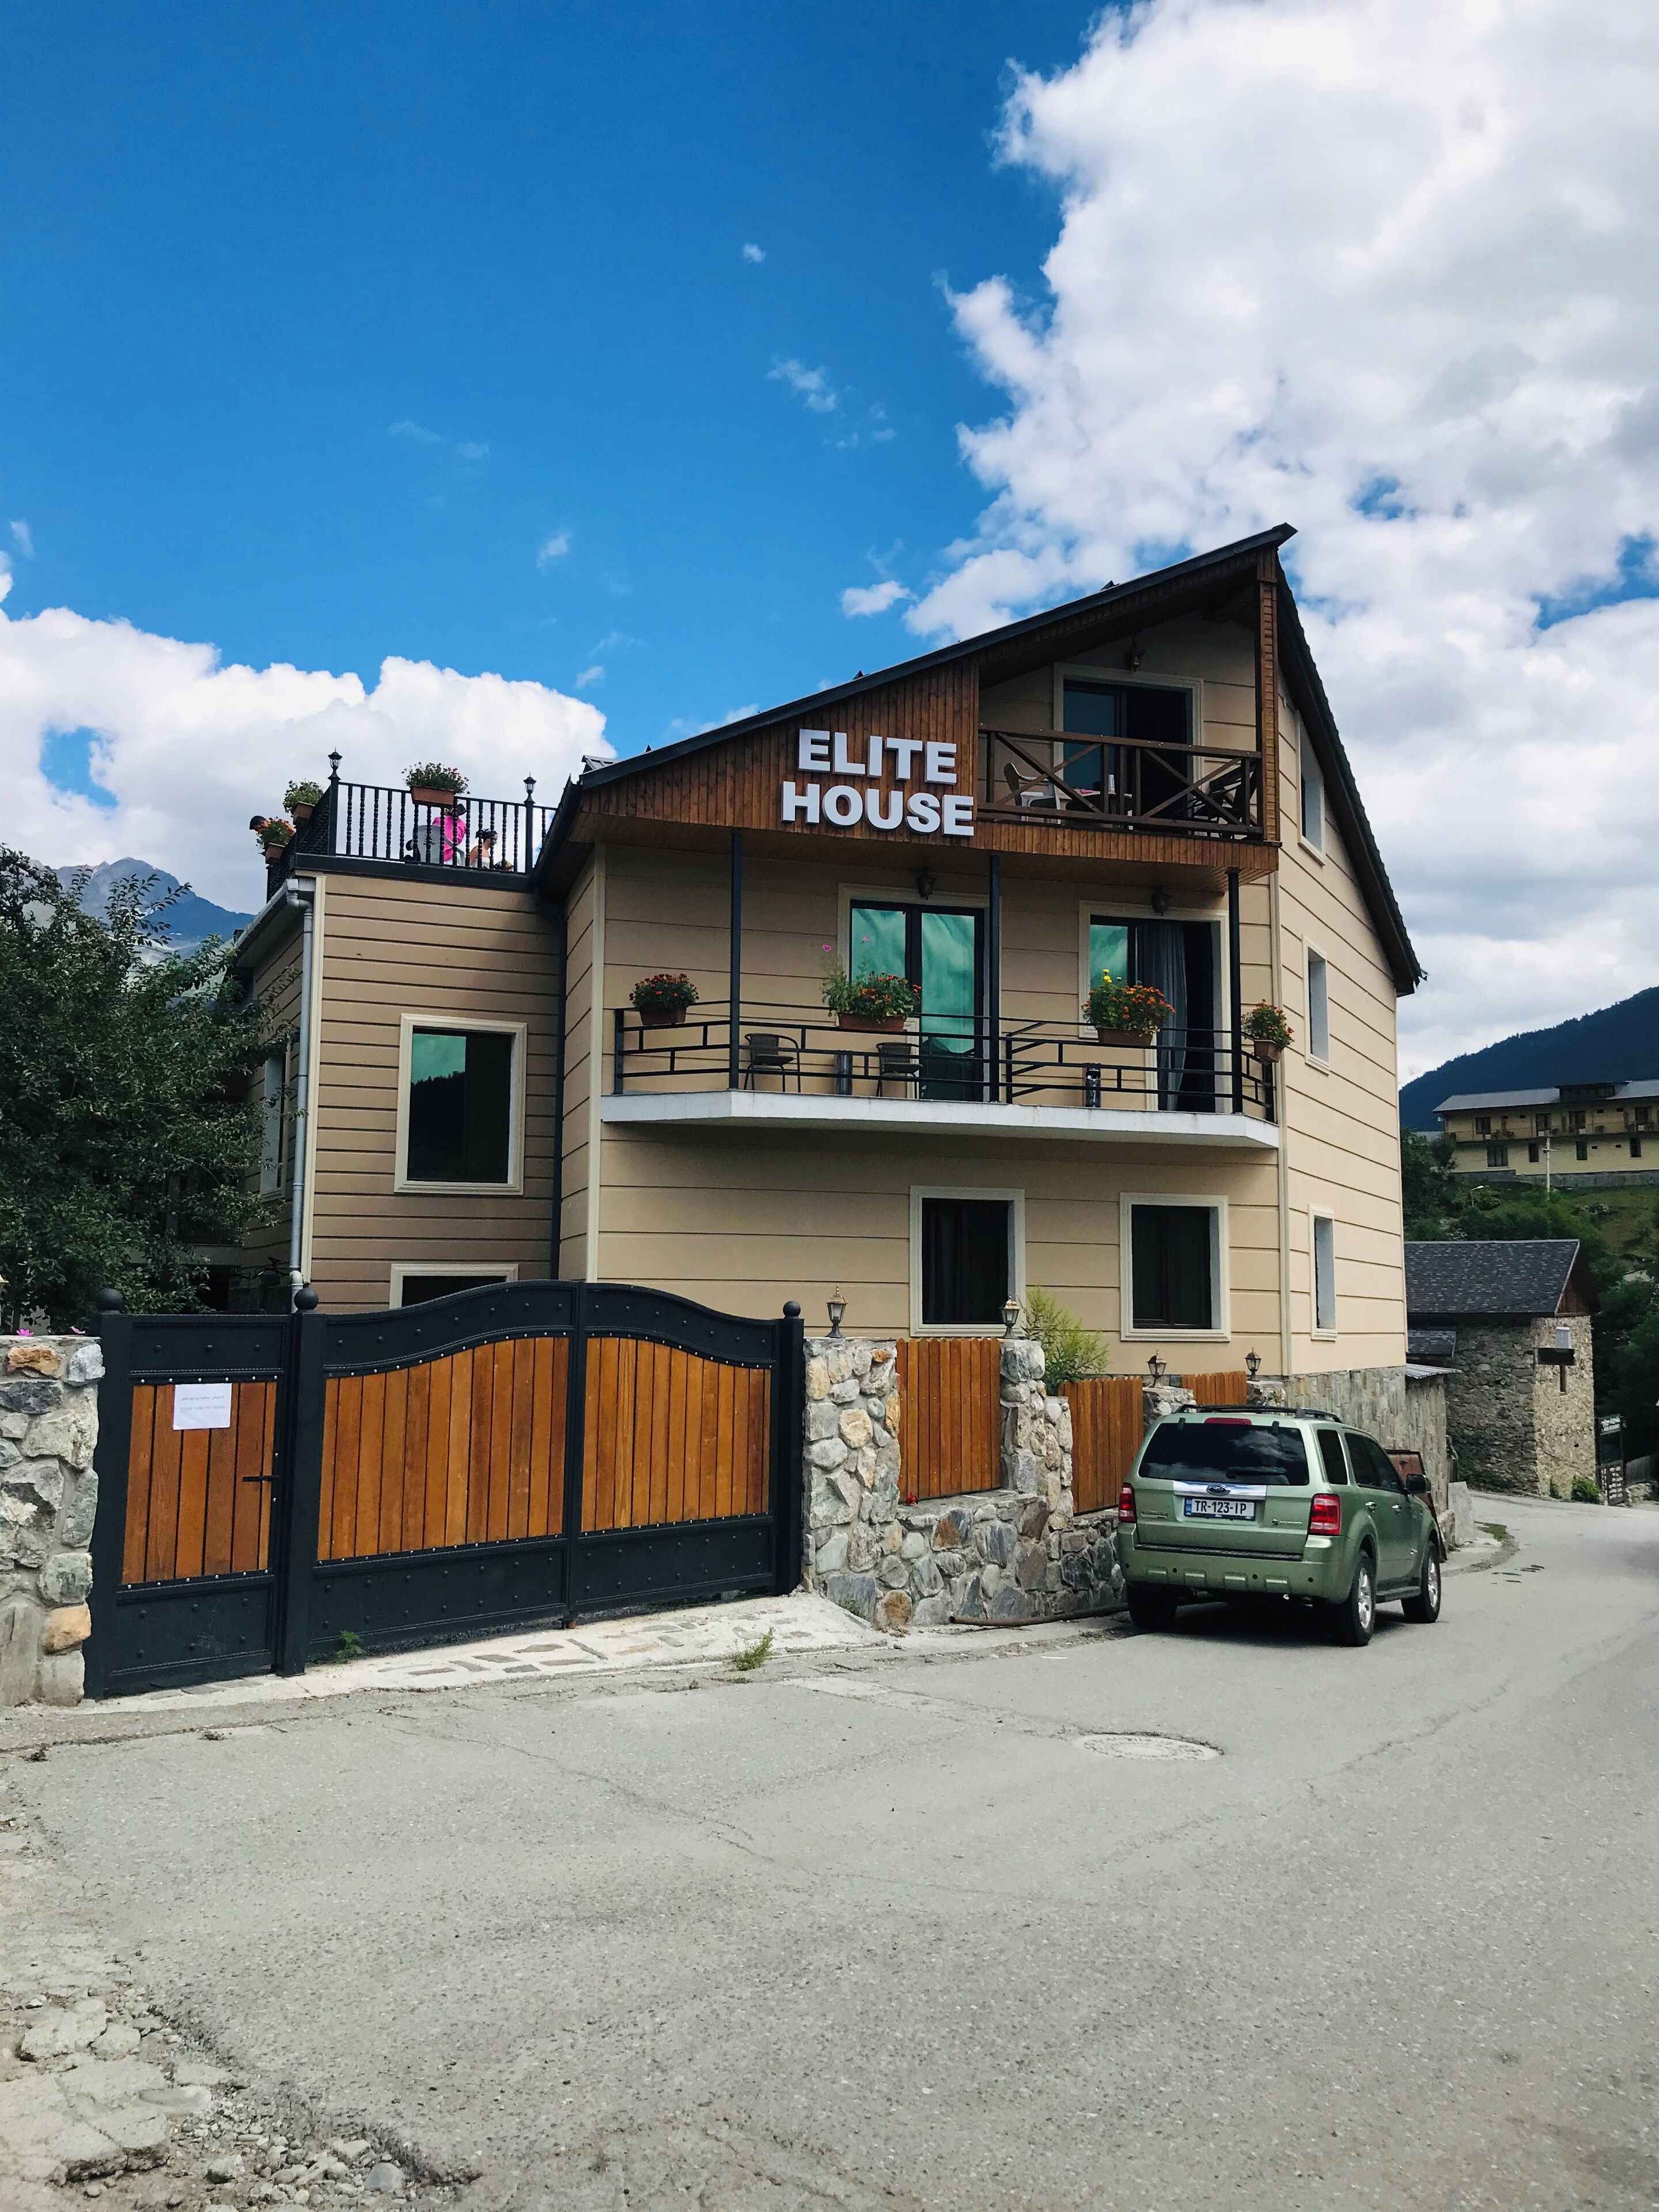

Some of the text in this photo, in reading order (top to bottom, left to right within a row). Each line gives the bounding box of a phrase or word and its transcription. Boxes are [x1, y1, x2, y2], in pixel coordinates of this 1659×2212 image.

[798, 728, 957, 784] ELITE
[782, 781, 975, 836] HOUSE
[1195, 1500, 1247, 1514] TR-123-IP
